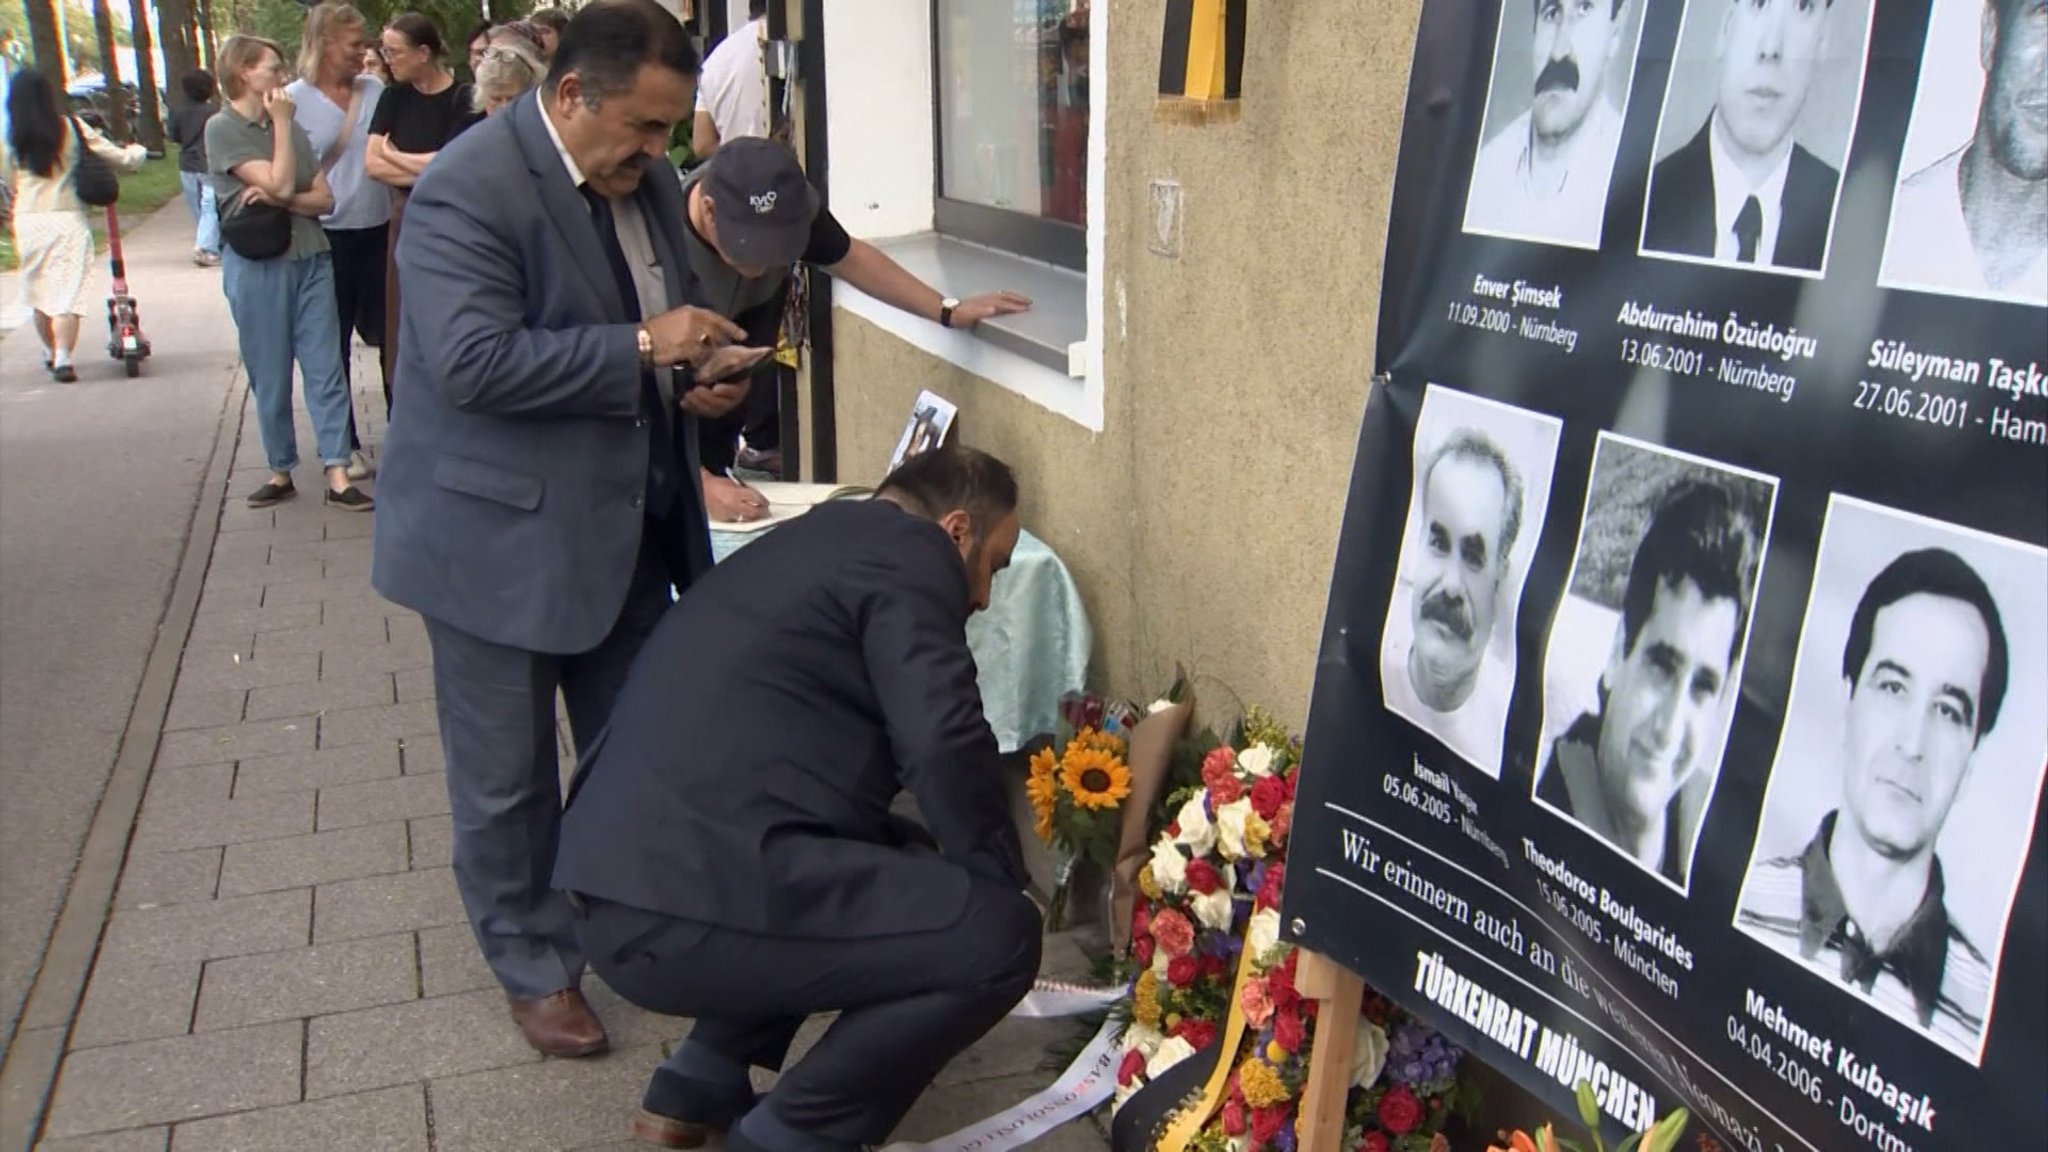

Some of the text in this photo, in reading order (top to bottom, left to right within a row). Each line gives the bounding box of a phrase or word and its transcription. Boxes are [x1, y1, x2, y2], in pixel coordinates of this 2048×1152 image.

[1473, 273, 1562, 308] Enver Şimsek
[1448, 301, 1510, 333] 11.09.2000
[1519, 316, 1578, 352] Nürnberg
[1617, 301, 1817, 361] Abdurrahim Özüdoğru
[1621, 338, 1703, 376] 13.06.2001
[1717, 357, 1796, 402] Nürnberg
[1867, 339, 1980, 384] Süleyman
[1853, 380, 1968, 429] 27.06.2001
[1990, 406, 2048, 446] Ham
[1383, 773, 1451, 824] 05.06.2005
[1341, 828, 1380, 874] Wir
[1384, 860, 1469, 924] erinnern
[1474, 909, 1524, 956] auch
[1529, 941, 1556, 976] an
[1561, 955, 1591, 999] die
[1522, 836, 1693, 970] Theodoros Boulgarides
[1536, 878, 1602, 943] 15.06.2005
[1613, 934, 1679, 1000] München
[1414, 950, 1538, 1061] TÜRKENRAT
[1535, 1026, 1656, 1133] MÜNCHEN
[1727, 1015, 1822, 1104] 04.04.2006
[1745, 987, 1833, 1067] Mehmet
[1837, 1047, 1937, 1132] Kubaşık
